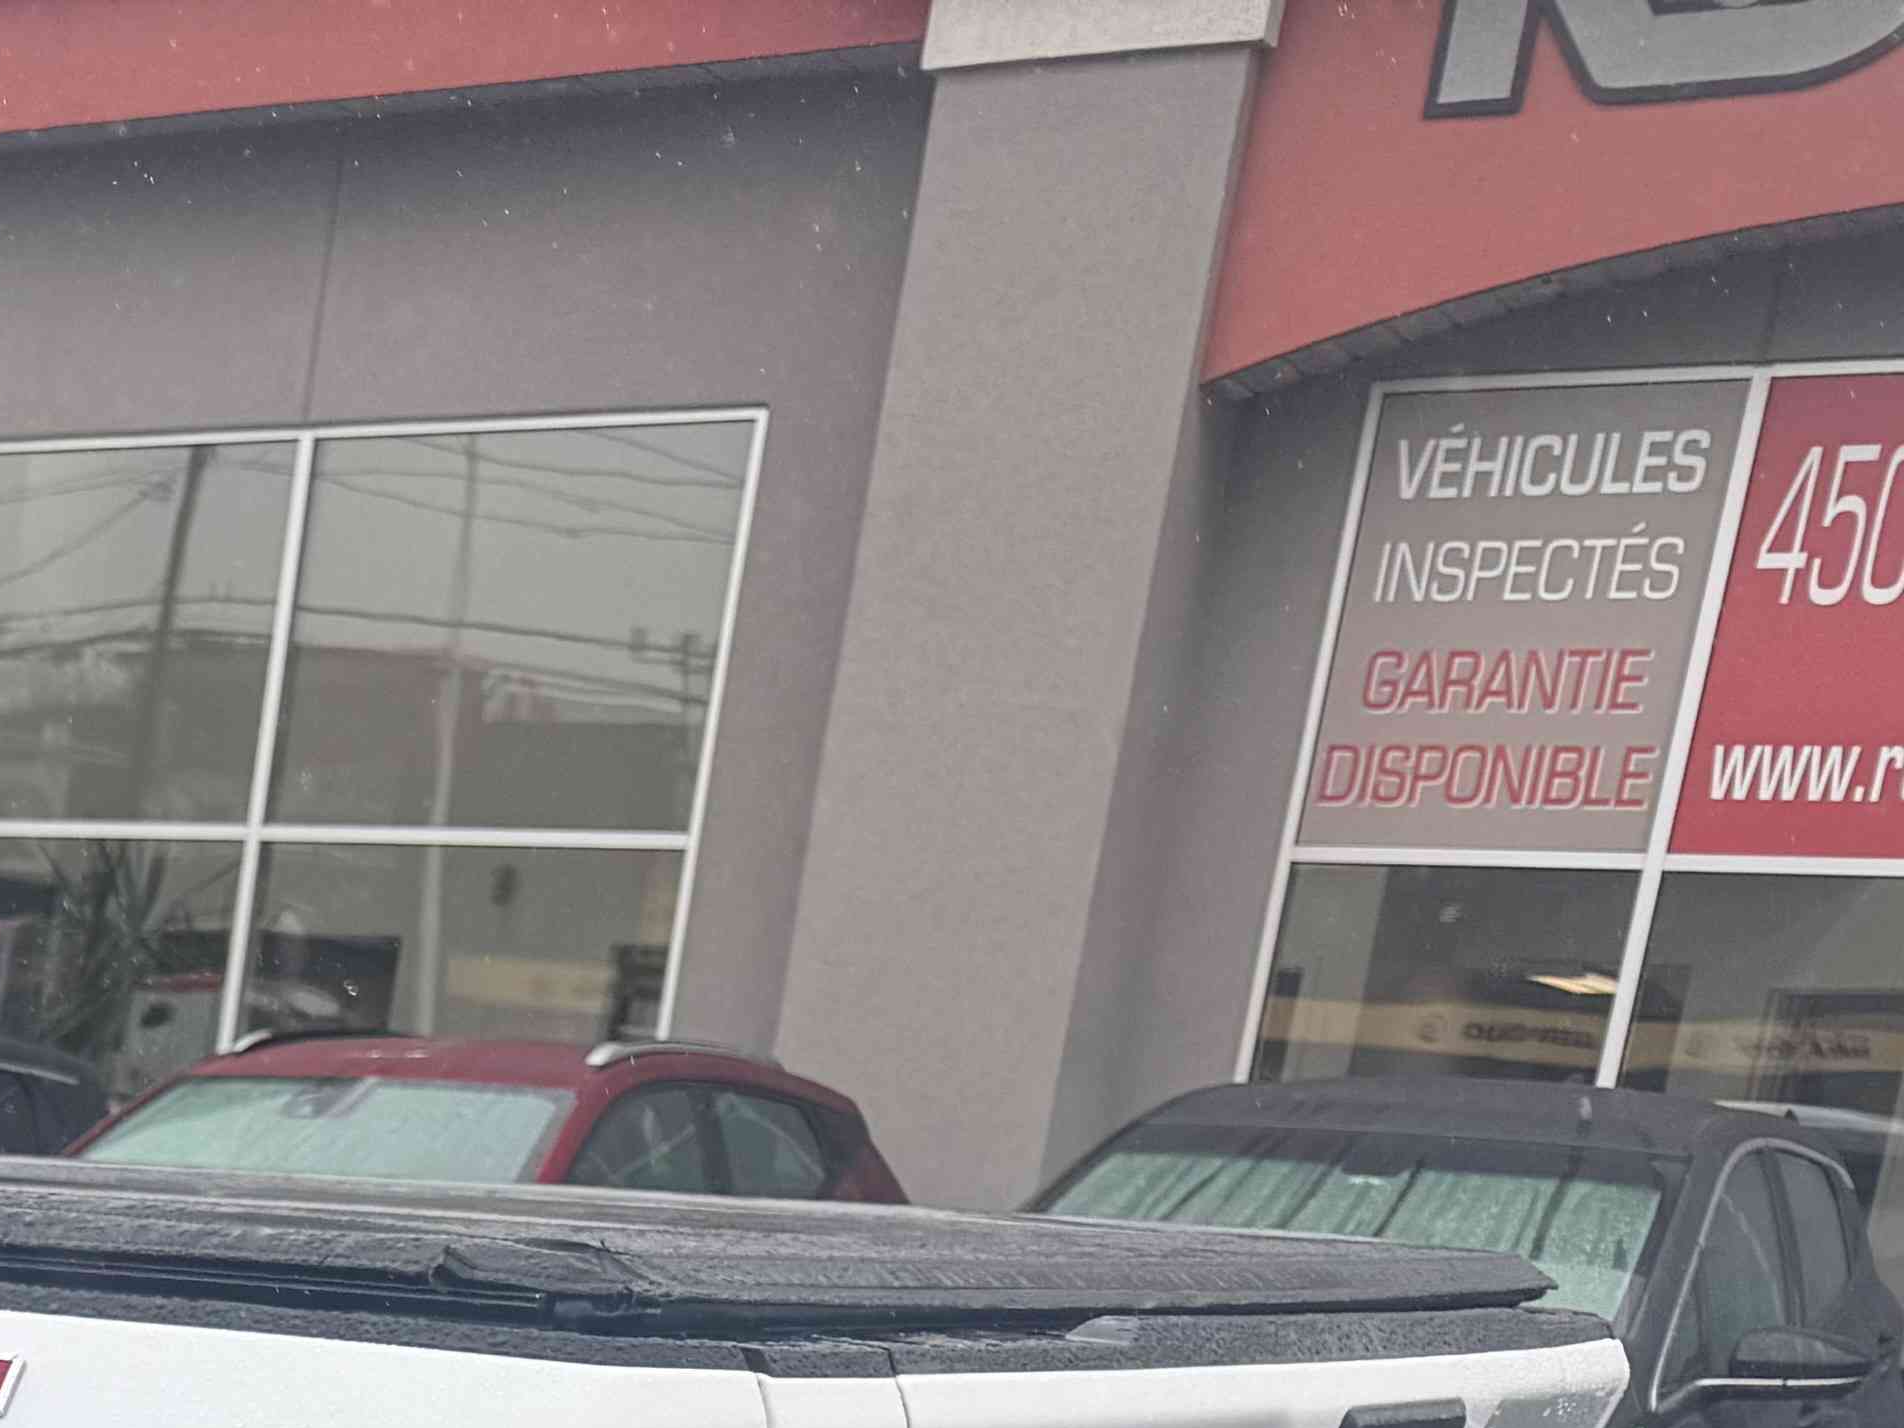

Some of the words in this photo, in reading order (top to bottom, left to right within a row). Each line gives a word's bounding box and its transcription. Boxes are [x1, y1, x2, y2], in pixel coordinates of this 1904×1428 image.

[1398, 423, 1712, 501] VÉHICULES
[1755, 443, 1904, 606] 450
[1375, 522, 1686, 603] INSPECTÉS
[1360, 648, 1655, 714] GARANTIE
[1307, 742, 1662, 811] DISPONIBLE
[1710, 744, 1904, 803] www.r
